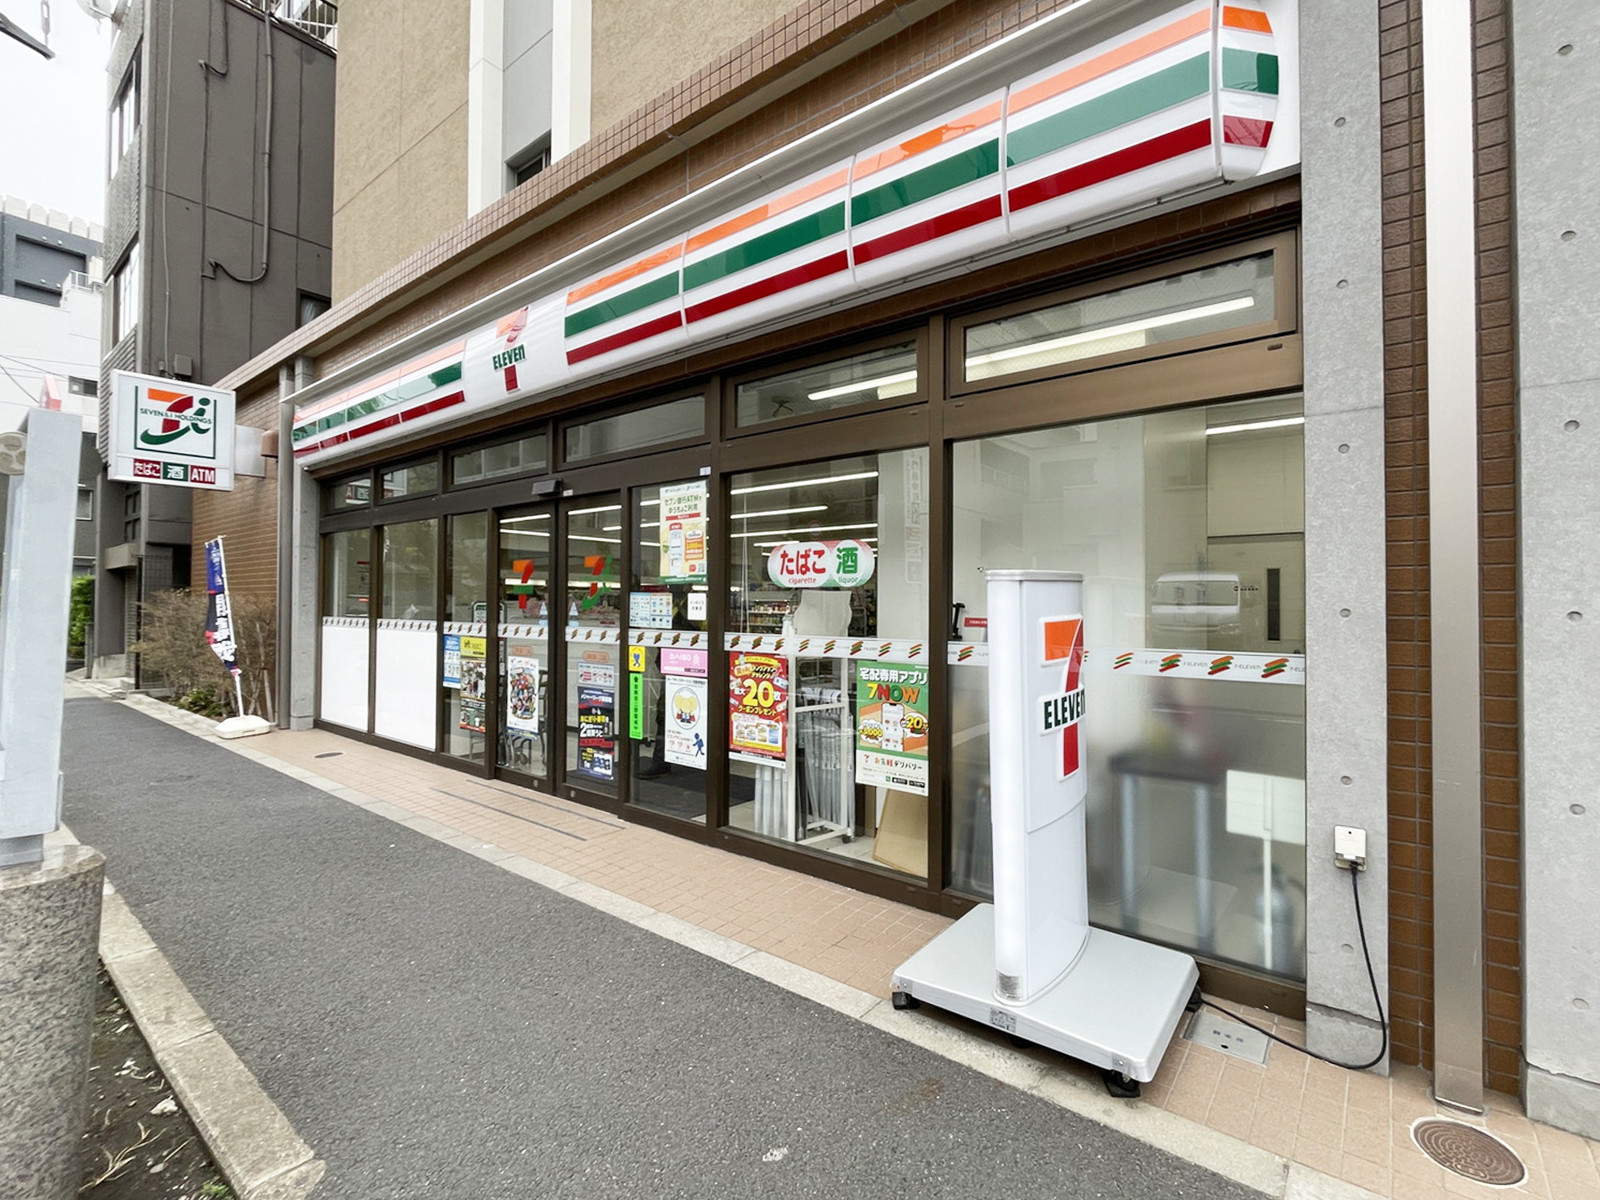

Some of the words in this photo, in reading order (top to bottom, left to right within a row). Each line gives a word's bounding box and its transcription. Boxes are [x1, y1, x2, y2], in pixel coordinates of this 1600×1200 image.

[134, 462, 161, 477] たばこ
[167, 464, 185, 480] 酒
[191, 468, 215, 483] ATM
[780, 548, 827, 576] たばこ
[836, 546, 859, 574] 酒
[788, 577, 817, 585] cigarette
[839, 576, 859, 585] liquor
[859, 667, 928, 684] 宅配専用アプリ
[867, 682, 920, 704] 7NOW
